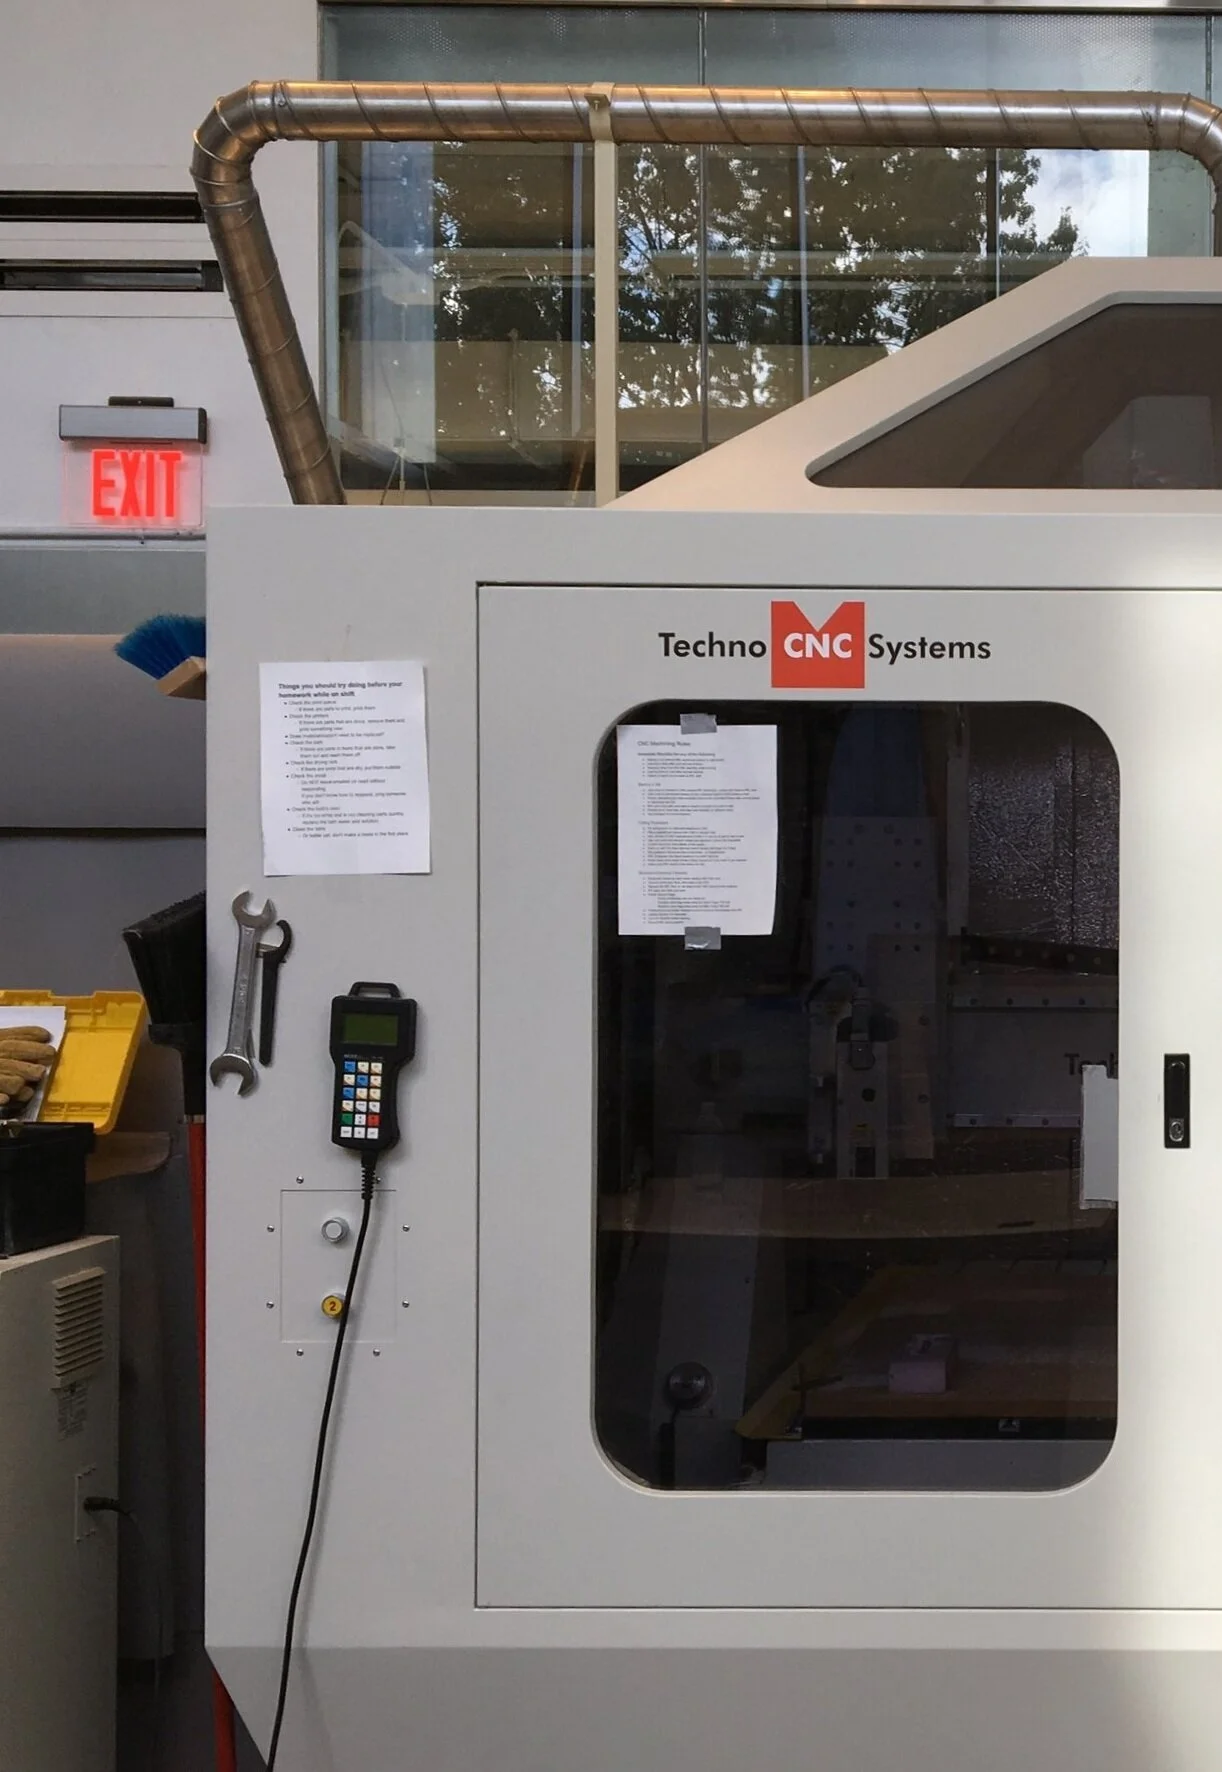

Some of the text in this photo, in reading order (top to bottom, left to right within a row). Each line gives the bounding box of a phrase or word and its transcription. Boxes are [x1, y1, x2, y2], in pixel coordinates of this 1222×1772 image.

[92, 450, 182, 517] EXIT
[658, 631, 992, 665] Techno CNC Systems
[329, 1301, 337, 1312] 2
